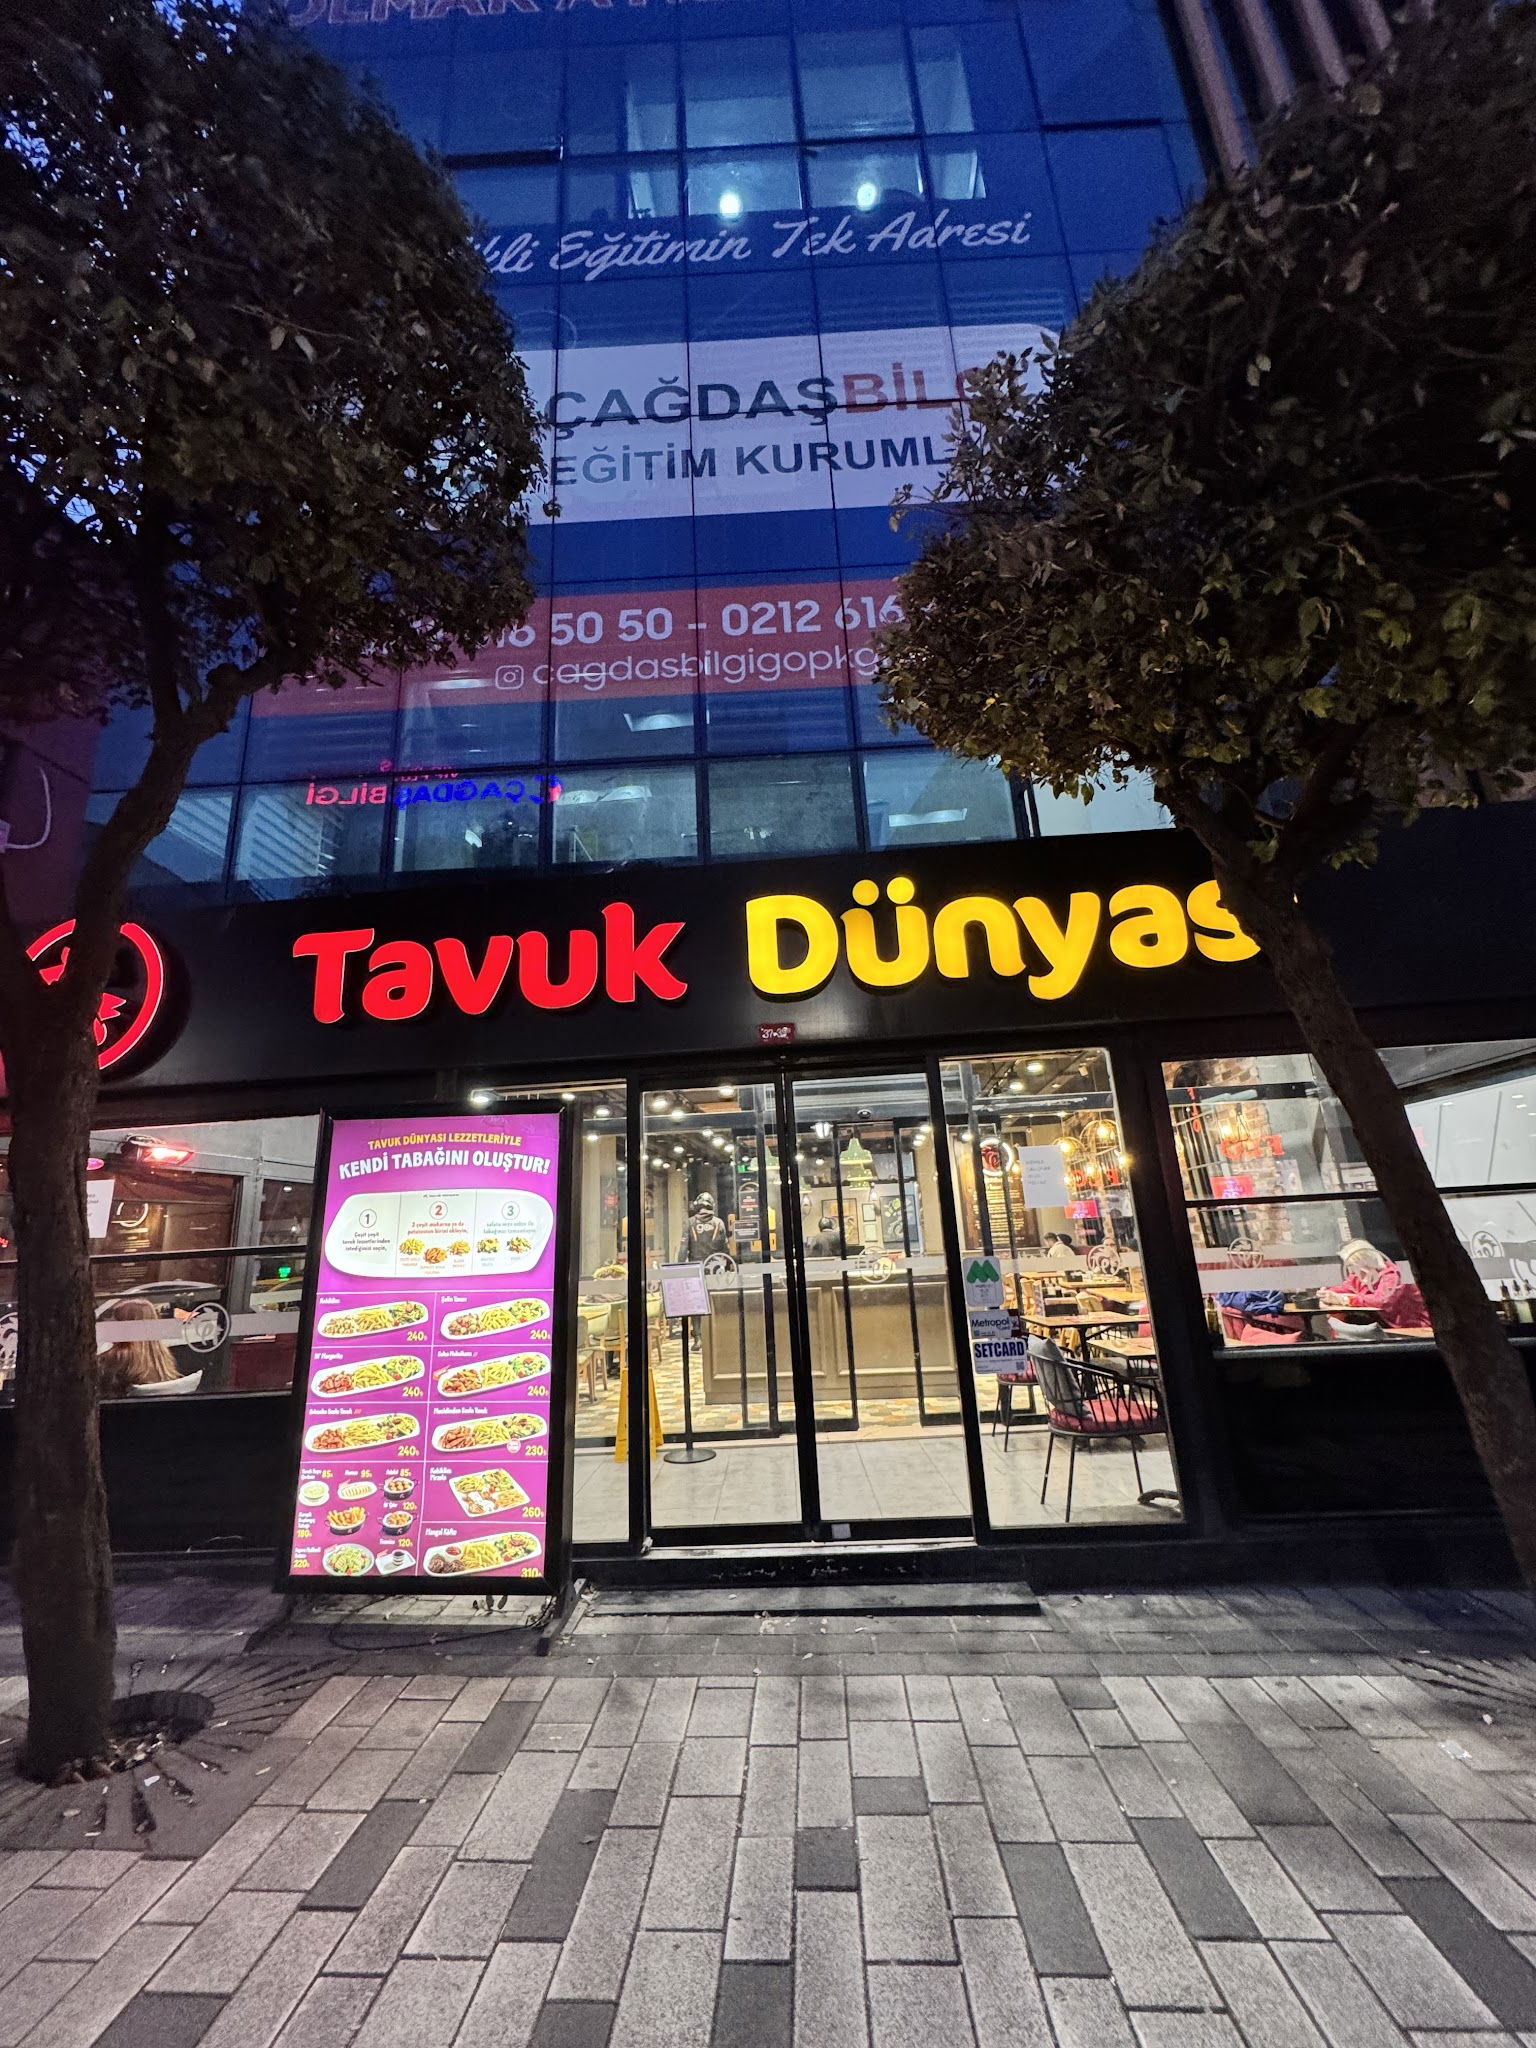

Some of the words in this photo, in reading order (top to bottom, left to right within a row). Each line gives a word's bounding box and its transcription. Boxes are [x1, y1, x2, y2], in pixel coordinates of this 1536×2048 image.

[550, 229, 751, 282] Eğitimin
[772, 215, 857, 258] Tek
[867, 208, 1032, 251] Adresi
[552, 441, 716, 486] EĞİTİM
[550, 613, 604, 646] 50
[618, 607, 673, 642] 50
[721, 600, 822, 636] 0212
[834, 594, 905, 631] 616
[292, 902, 688, 1024] Tavuk
[746, 876, 1262, 1000] Dünyas
[368, 1136, 402, 1150] TAVUK
[403, 1133, 446, 1146] DÜNYASI
[449, 1133, 522, 1146] LEZZETLERİYLE
[339, 1152, 388, 1179] KENDİ
[391, 1147, 469, 1169] TABAĞINI
[472, 1150, 551, 1174] OLUŞTUR!
[435, 1205, 443, 1216] 2
[507, 1205, 515, 1217] 3
[971, 1317, 1010, 1328] Metropol
[974, 1341, 1025, 1358] SETCARD
